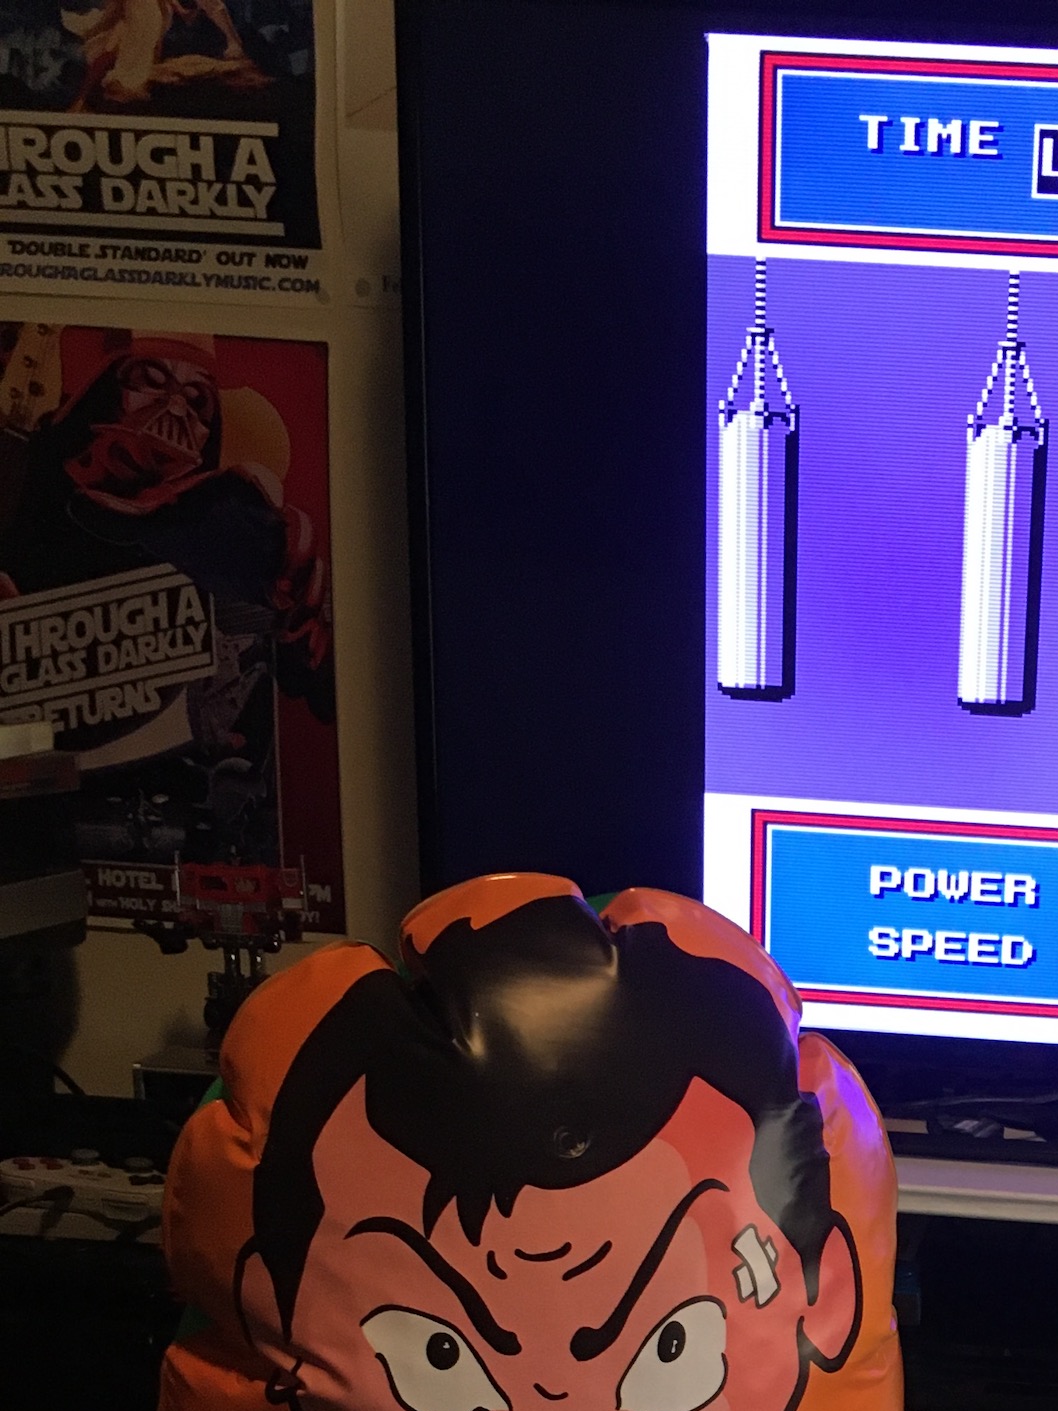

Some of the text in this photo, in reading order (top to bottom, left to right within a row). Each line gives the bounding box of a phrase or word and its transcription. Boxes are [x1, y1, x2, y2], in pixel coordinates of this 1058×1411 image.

[0, 126, 277, 183] ROUGH A
[858, 114, 1004, 159] TIME
[101, 176, 277, 219] DARKLY
[216, 251, 256, 267] OUT
[265, 254, 308, 269] NOW
[175, 584, 206, 627] A
[0, 621, 208, 694] GLASS DARKLY
[98, 868, 164, 891] HOTEL
[869, 864, 1040, 909] POWER
[868, 925, 1037, 970] SPEED
